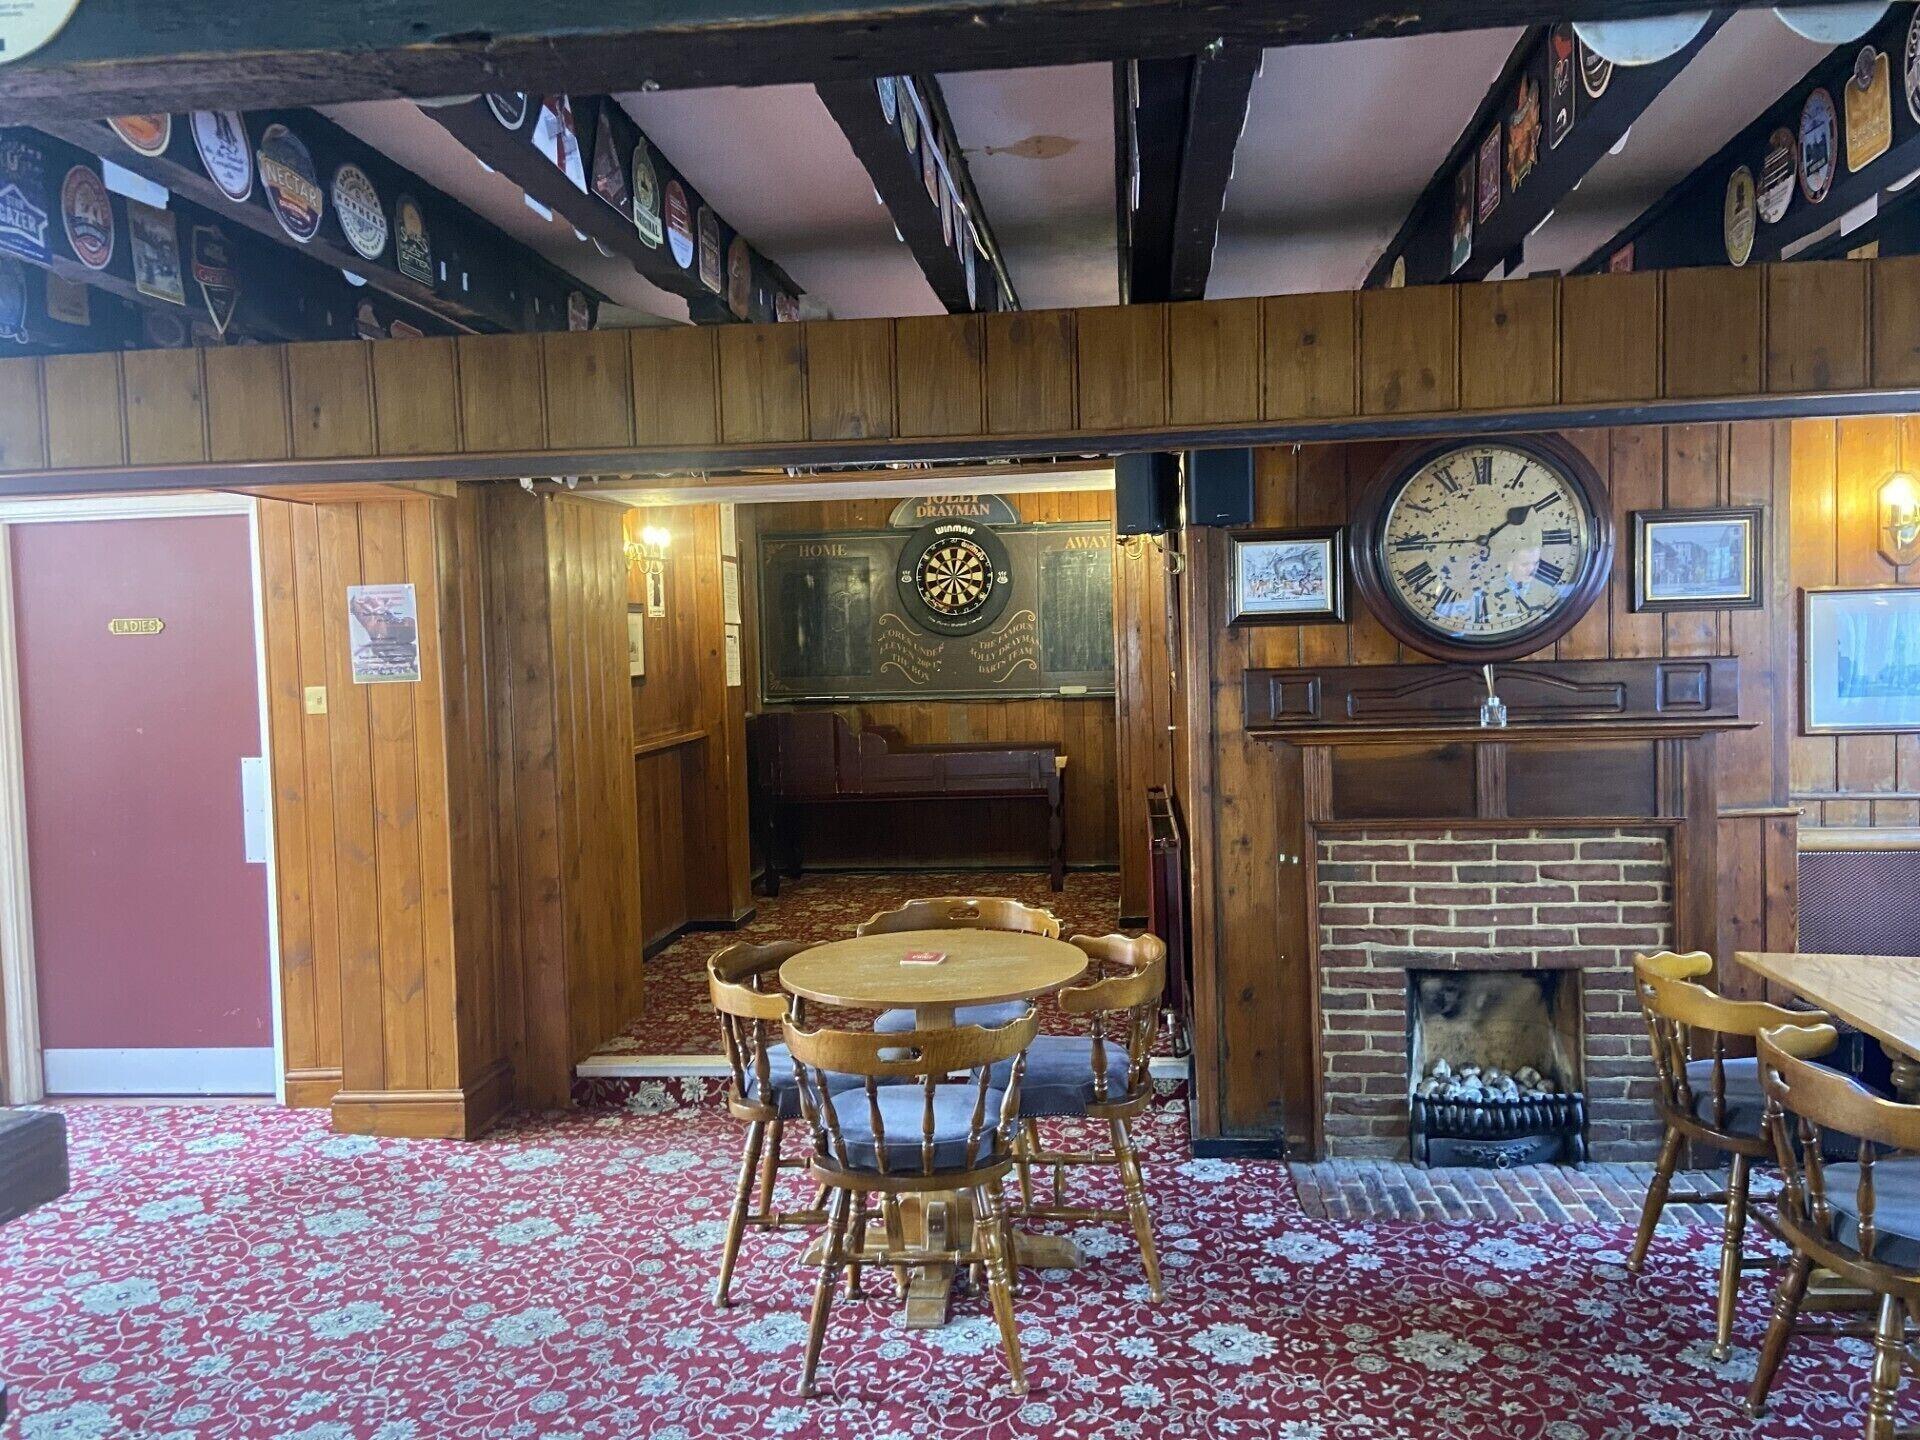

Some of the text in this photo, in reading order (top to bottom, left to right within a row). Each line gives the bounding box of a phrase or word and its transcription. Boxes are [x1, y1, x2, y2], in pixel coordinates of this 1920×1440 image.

[265, 163, 318, 207] NECTAR
[916, 504, 990, 517] DRAYMAN
[1065, 536, 1109, 549] AWAY
[799, 543, 847, 557] HOME
[114, 620, 156, 632] LADIES
